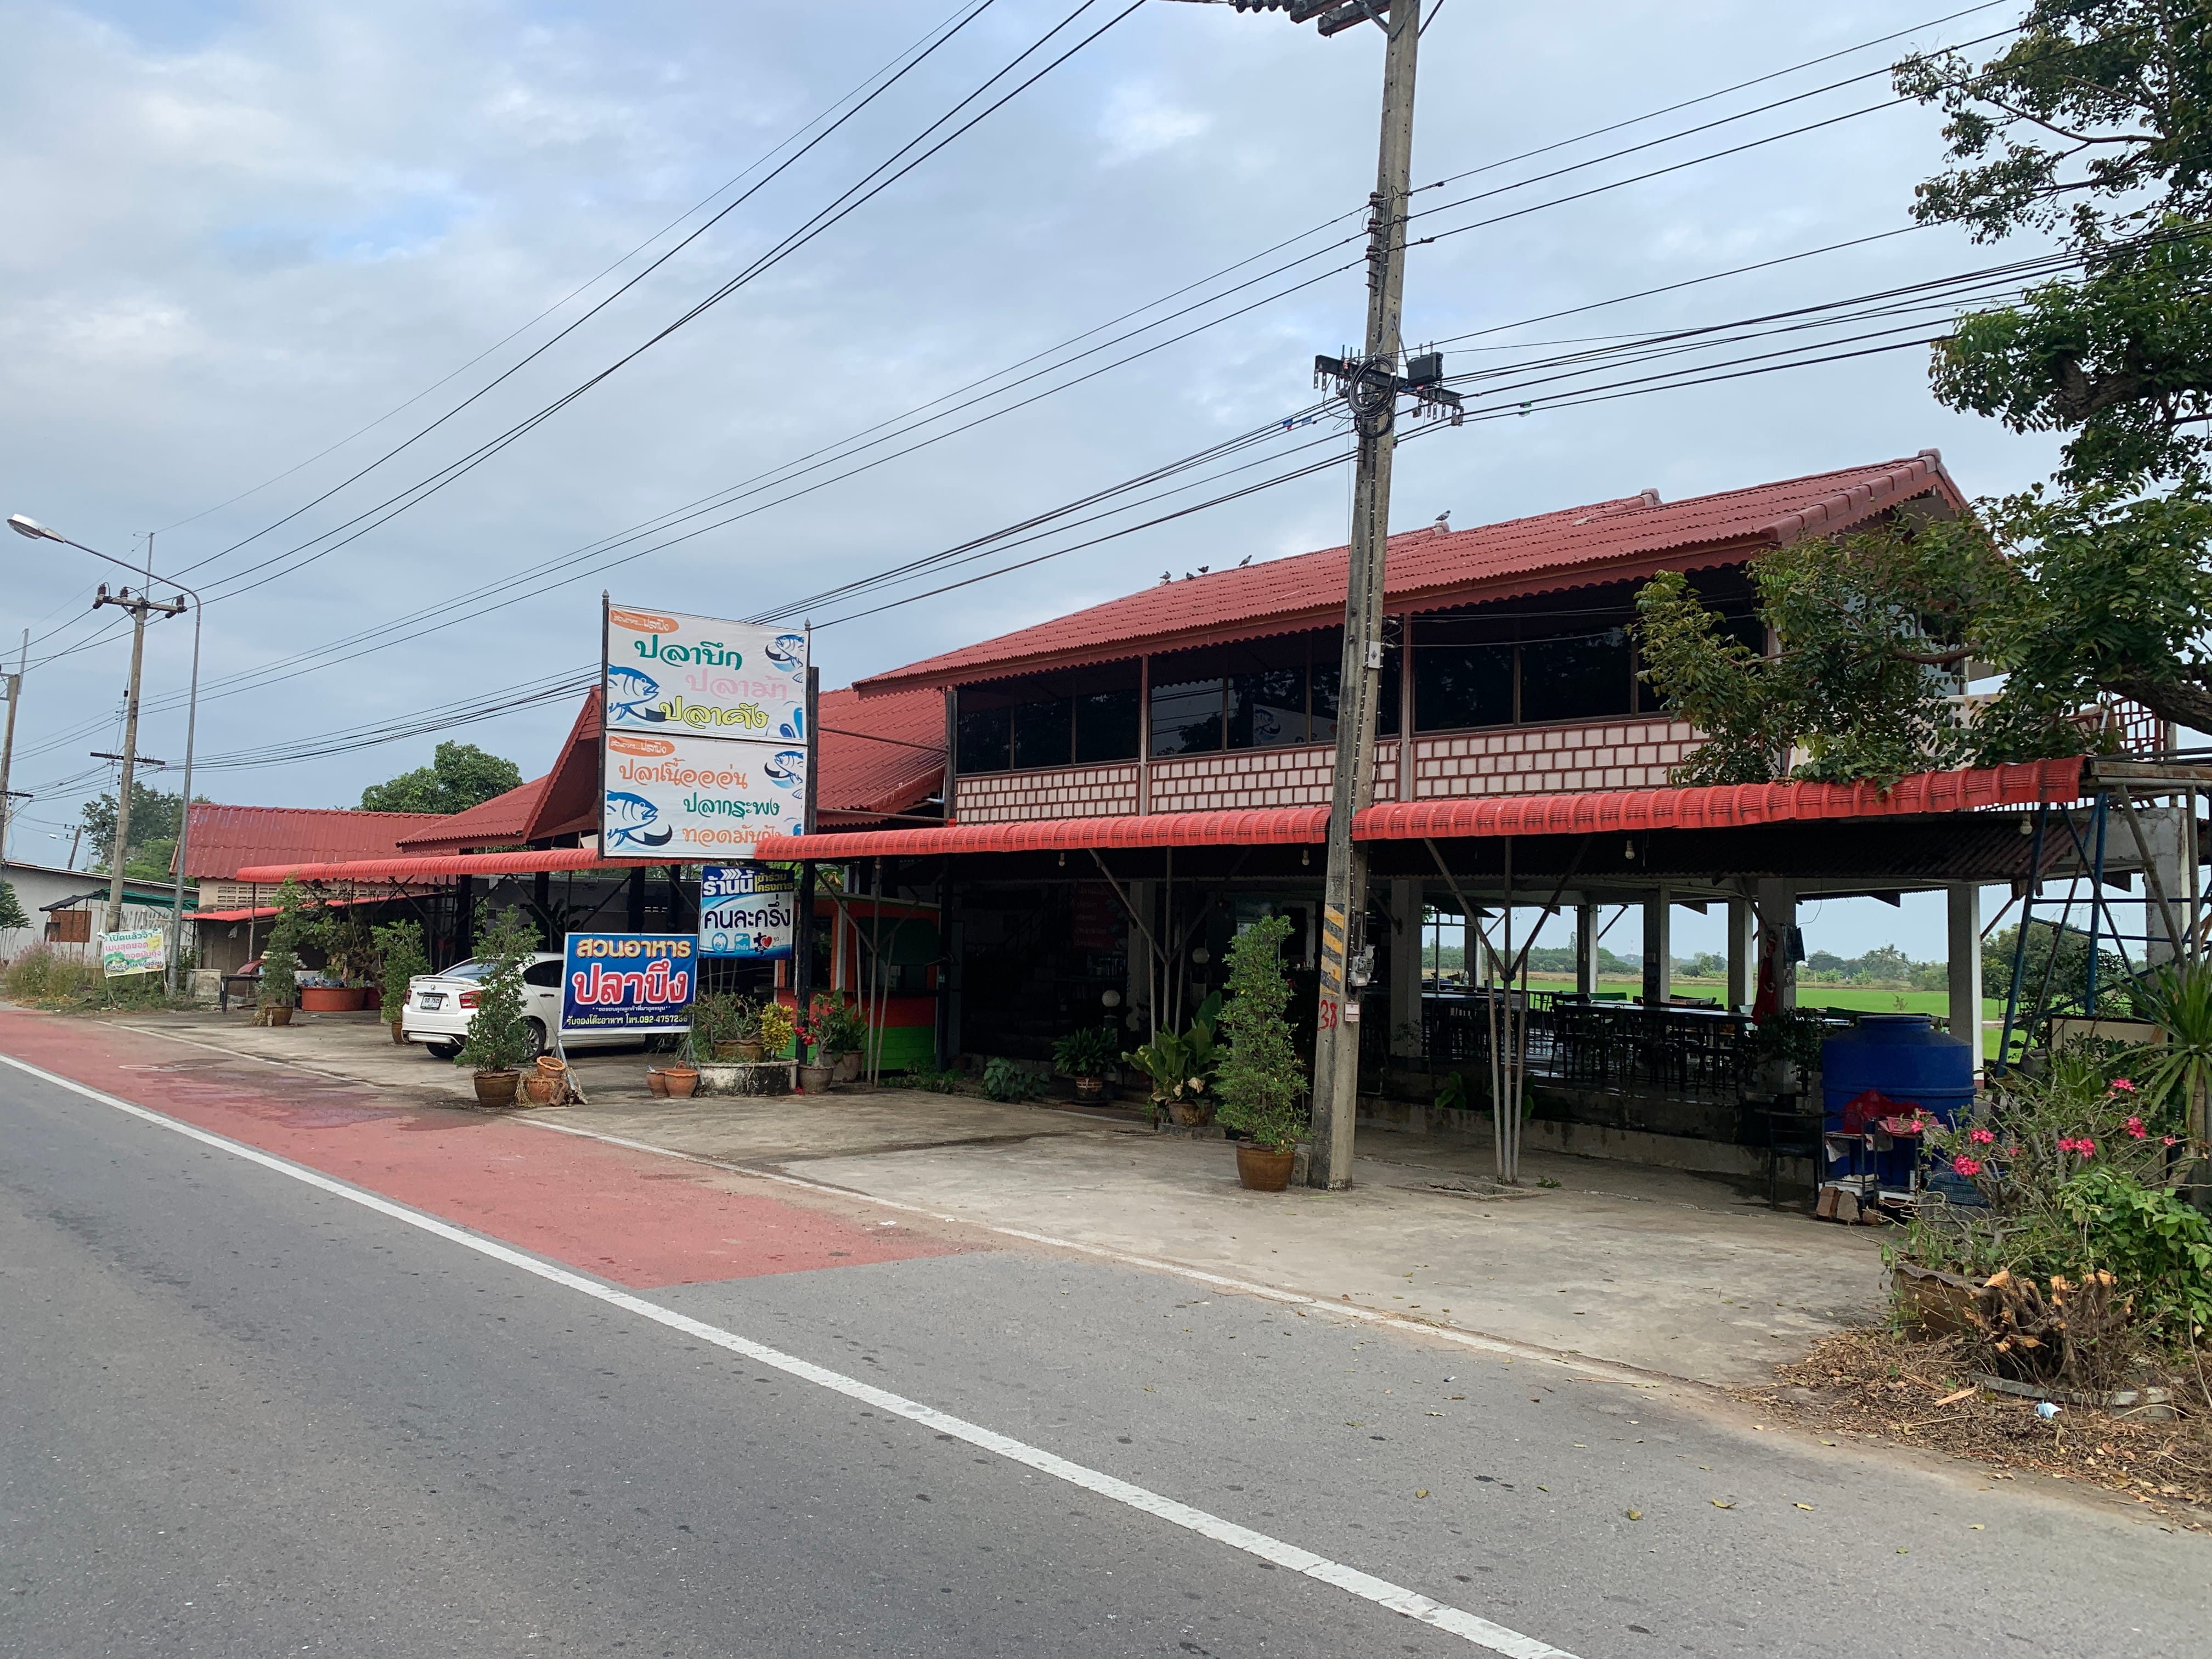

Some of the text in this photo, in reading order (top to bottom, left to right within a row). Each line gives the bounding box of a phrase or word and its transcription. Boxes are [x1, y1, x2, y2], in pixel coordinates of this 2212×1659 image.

[634, 634, 742, 670] ปลาบึก
[686, 668, 787, 701] ปลาม้า
[659, 695, 769, 729] ปลาคัง
[684, 792, 780, 820] ปลากระพง
[703, 870, 754, 895] ร้านนี้
[754, 872, 787, 883] เข้าร่วม
[754, 882, 793, 892] โครงการ
[704, 894, 790, 929] คนละครึ่ง
[576, 938, 691, 957] สวนอาหาร
[572, 959, 688, 1005] ปลาบึง
[1317, 1000, 1338, 1031] 38
